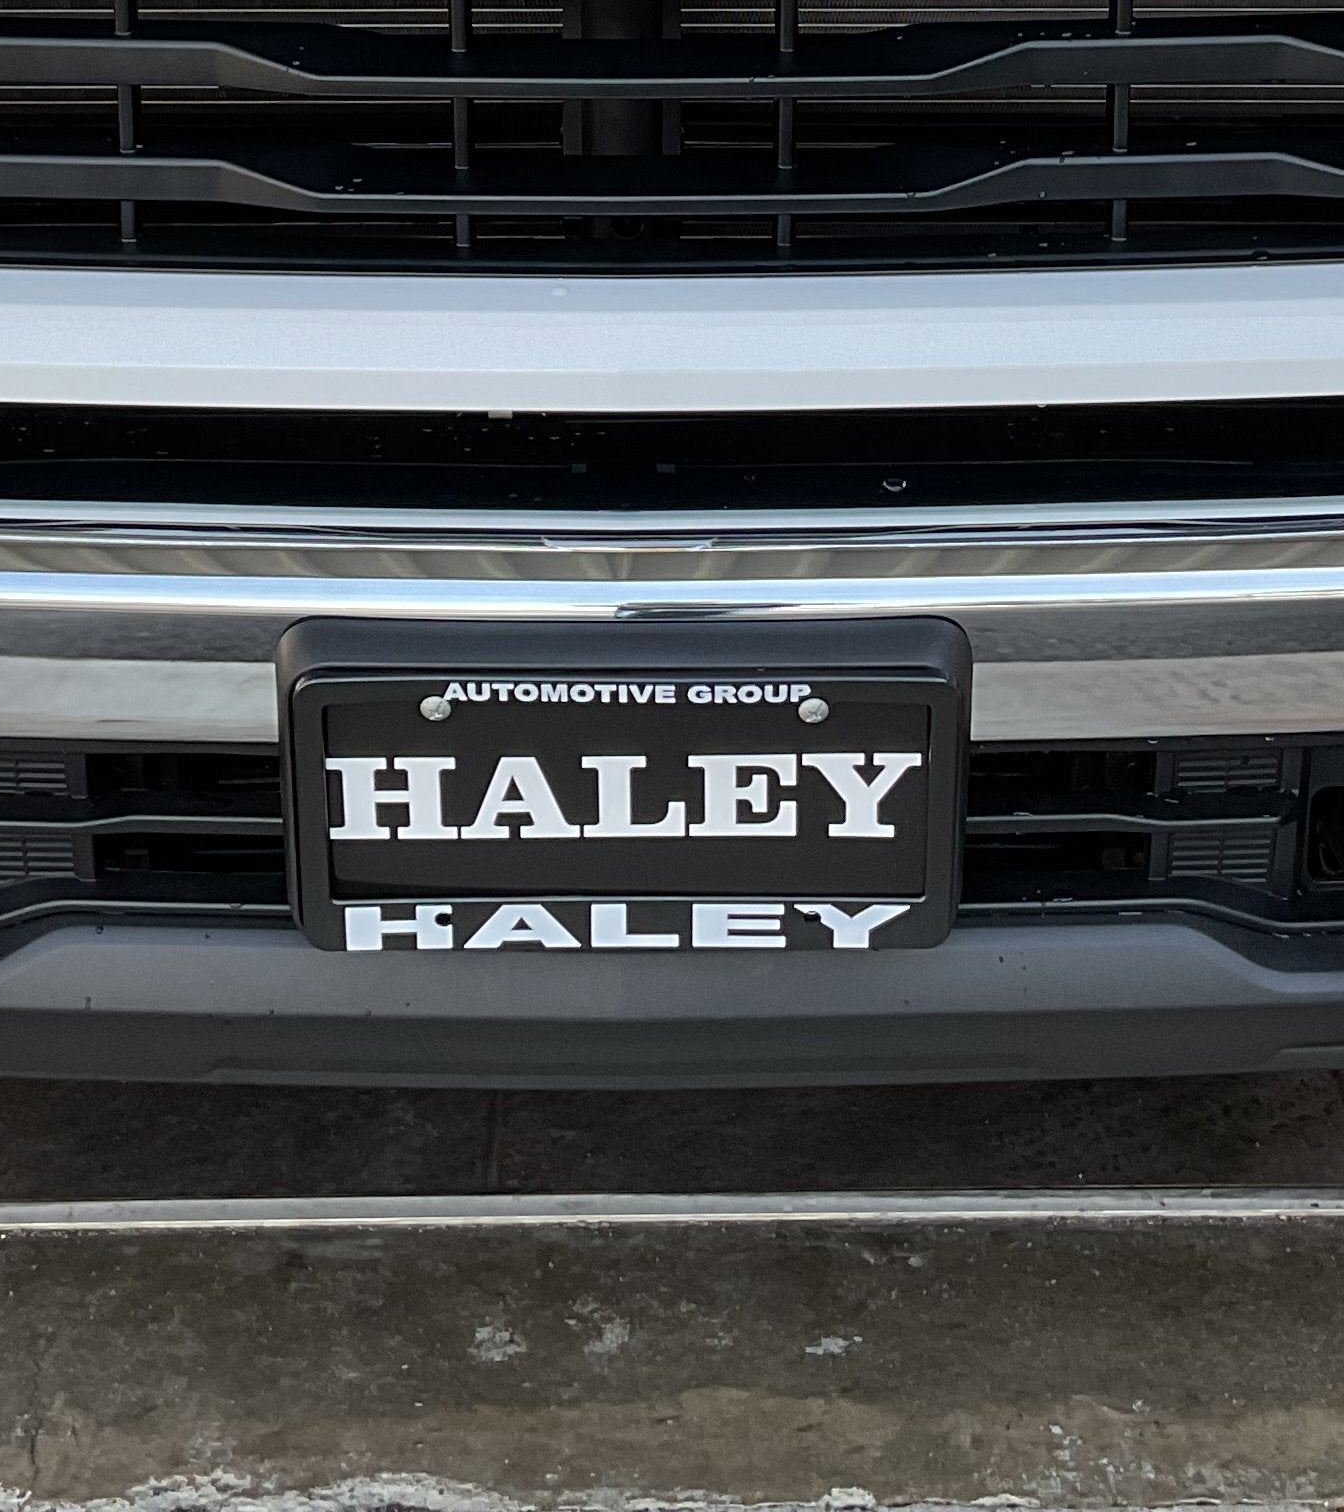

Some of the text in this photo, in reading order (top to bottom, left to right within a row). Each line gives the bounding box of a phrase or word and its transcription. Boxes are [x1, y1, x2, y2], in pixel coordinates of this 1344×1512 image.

[443, 681, 812, 704] AUTOMOTIVE GROUP
[326, 752, 922, 840] HALEY
[344, 903, 911, 951] HALEY
